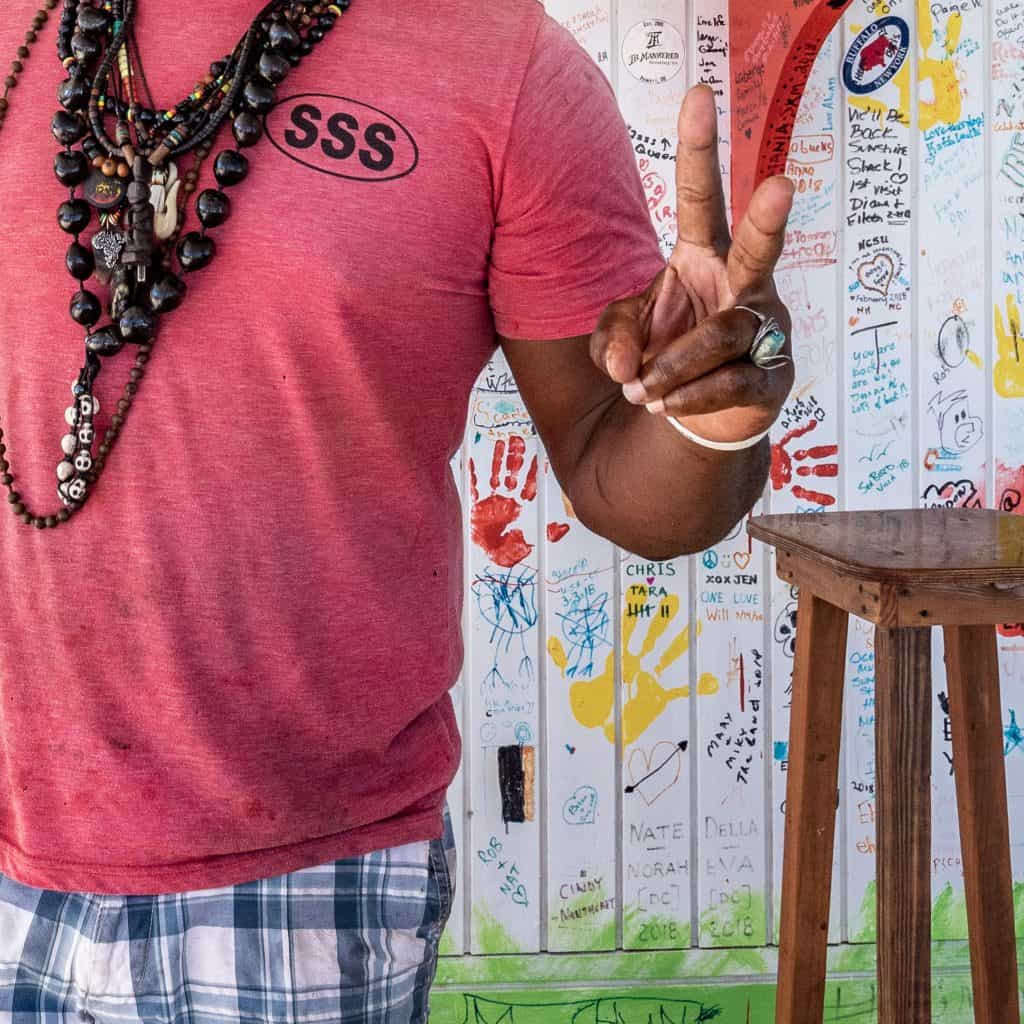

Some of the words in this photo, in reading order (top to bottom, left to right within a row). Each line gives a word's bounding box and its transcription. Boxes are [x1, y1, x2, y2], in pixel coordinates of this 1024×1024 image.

[846, 23, 878, 65] BUFFALO
[283, 103, 397, 172] SSS
[850, 123, 899, 140] Back
[625, 563, 677, 578] CHRIS
[733, 574, 759, 586] JEN
[629, 584, 668, 598] TARA
[701, 591, 725, 605] ONE
[732, 591, 760, 606] LOVE
[629, 823, 684, 844] NATE
[704, 816, 758, 839] DELLA
[628, 860, 689, 880] NORAH
[706, 857, 754, 875] EVA
